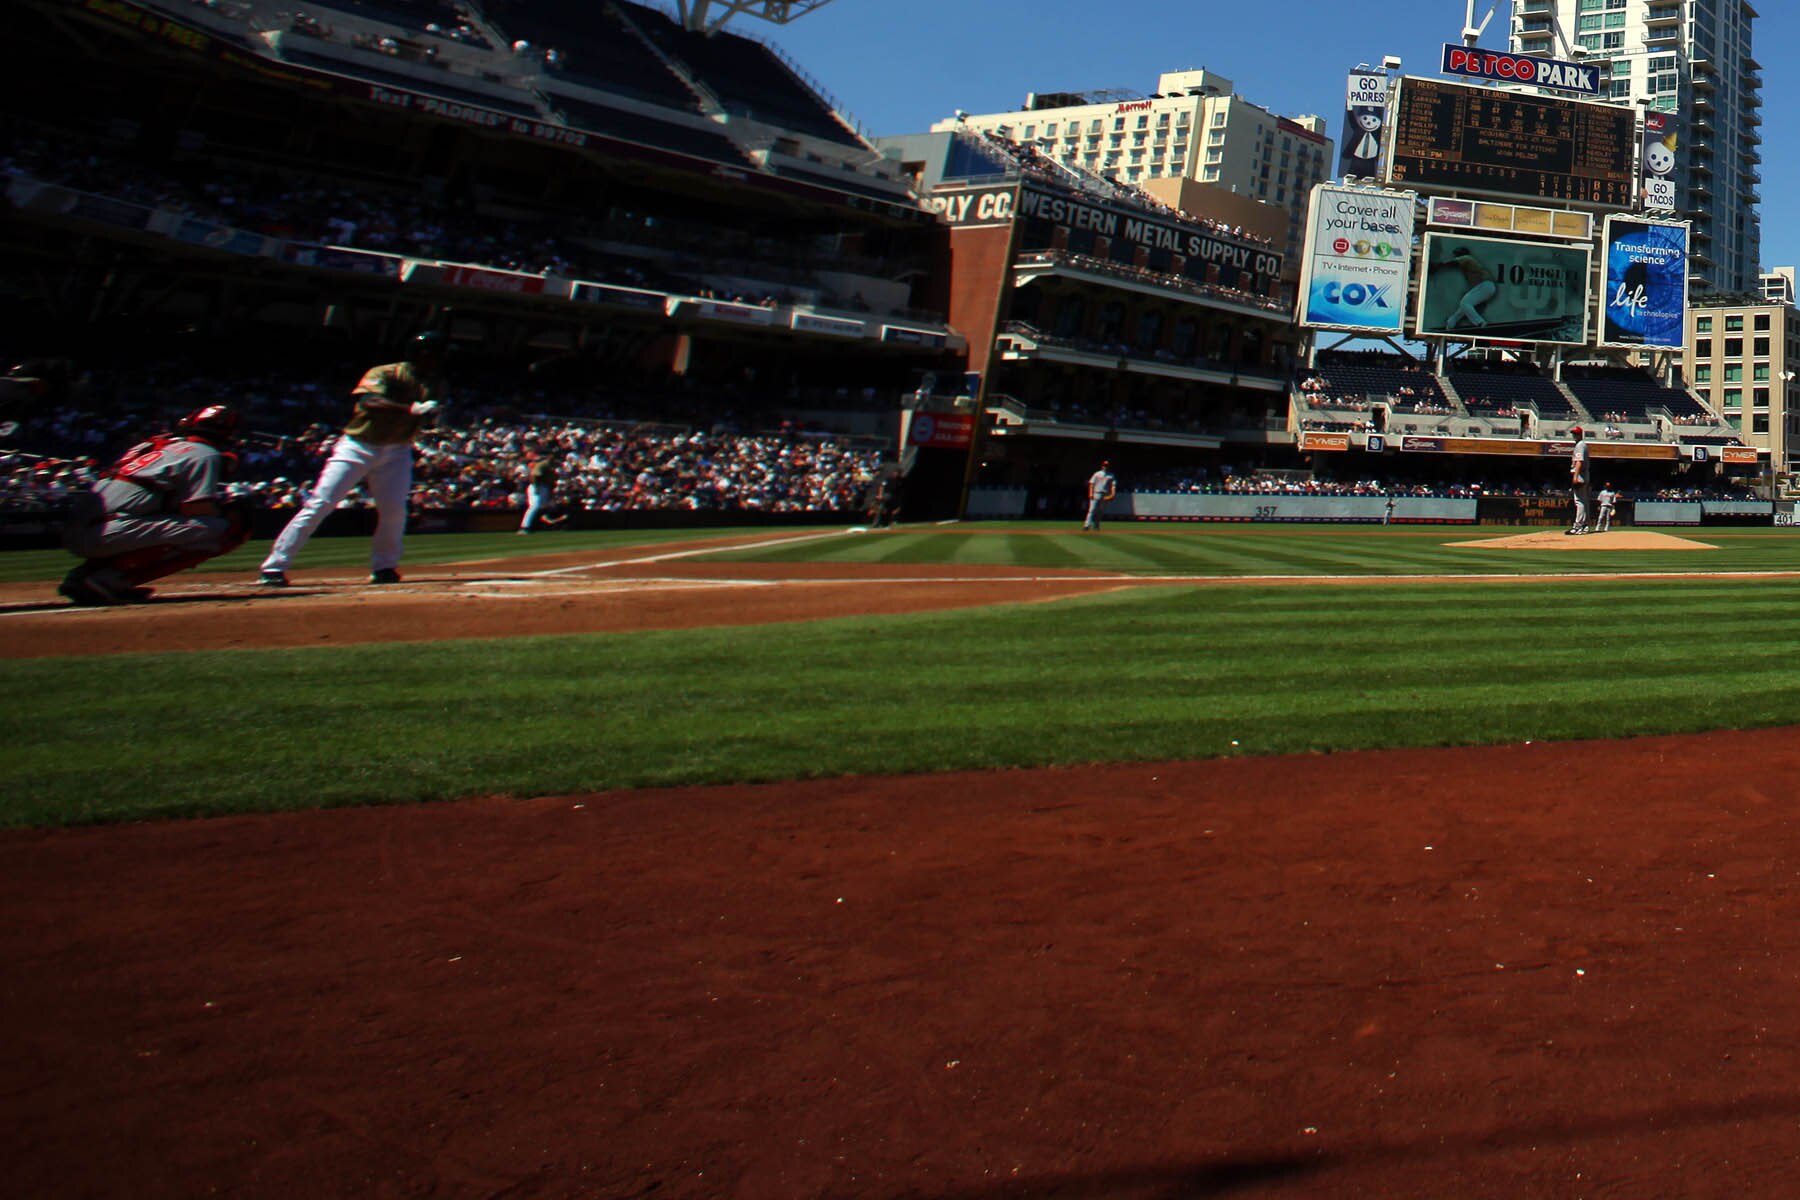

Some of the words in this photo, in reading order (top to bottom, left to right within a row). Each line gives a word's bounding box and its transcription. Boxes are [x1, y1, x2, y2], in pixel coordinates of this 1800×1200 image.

[1450, 50, 1535, 80] PETCO
[1537, 62, 1592, 90] PARK
[1359, 78, 1377, 90] GO
[1351, 91, 1385, 103] PADRES
[1116, 100, 1152, 113] Marriott
[1653, 184, 1667, 194] GO
[976, 191, 1014, 221] CO.
[1648, 194, 1674, 206] TACOS
[1336, 201, 1378, 217] Cover
[1381, 206, 1397, 219] all
[1326, 218, 1358, 230] your
[1360, 217, 1402, 234] bases.
[1021, 190, 1118, 237] WESTERN
[1124, 219, 1184, 254] METAL
[1187, 236, 1251, 270] SUPPLY
[1255, 254, 1280, 278] CO.
[1615, 241, 1680, 258] Transforming
[1629, 254, 1665, 265] science
[1322, 261, 1333, 269] TV
[1338, 262, 1368, 273] Internet
[1373, 266, 1398, 275] Phone
[1496, 263, 1525, 286] 10
[1323, 281, 1391, 311] COX
[1610, 282, 1649, 318] life
[1305, 436, 1348, 447] CYMER
[1723, 449, 1757, 460] CYMER
[1538, 498, 1569, 508] BAILEY
[1255, 506, 1277, 517] 357
[1776, 514, 1793, 524] 401
